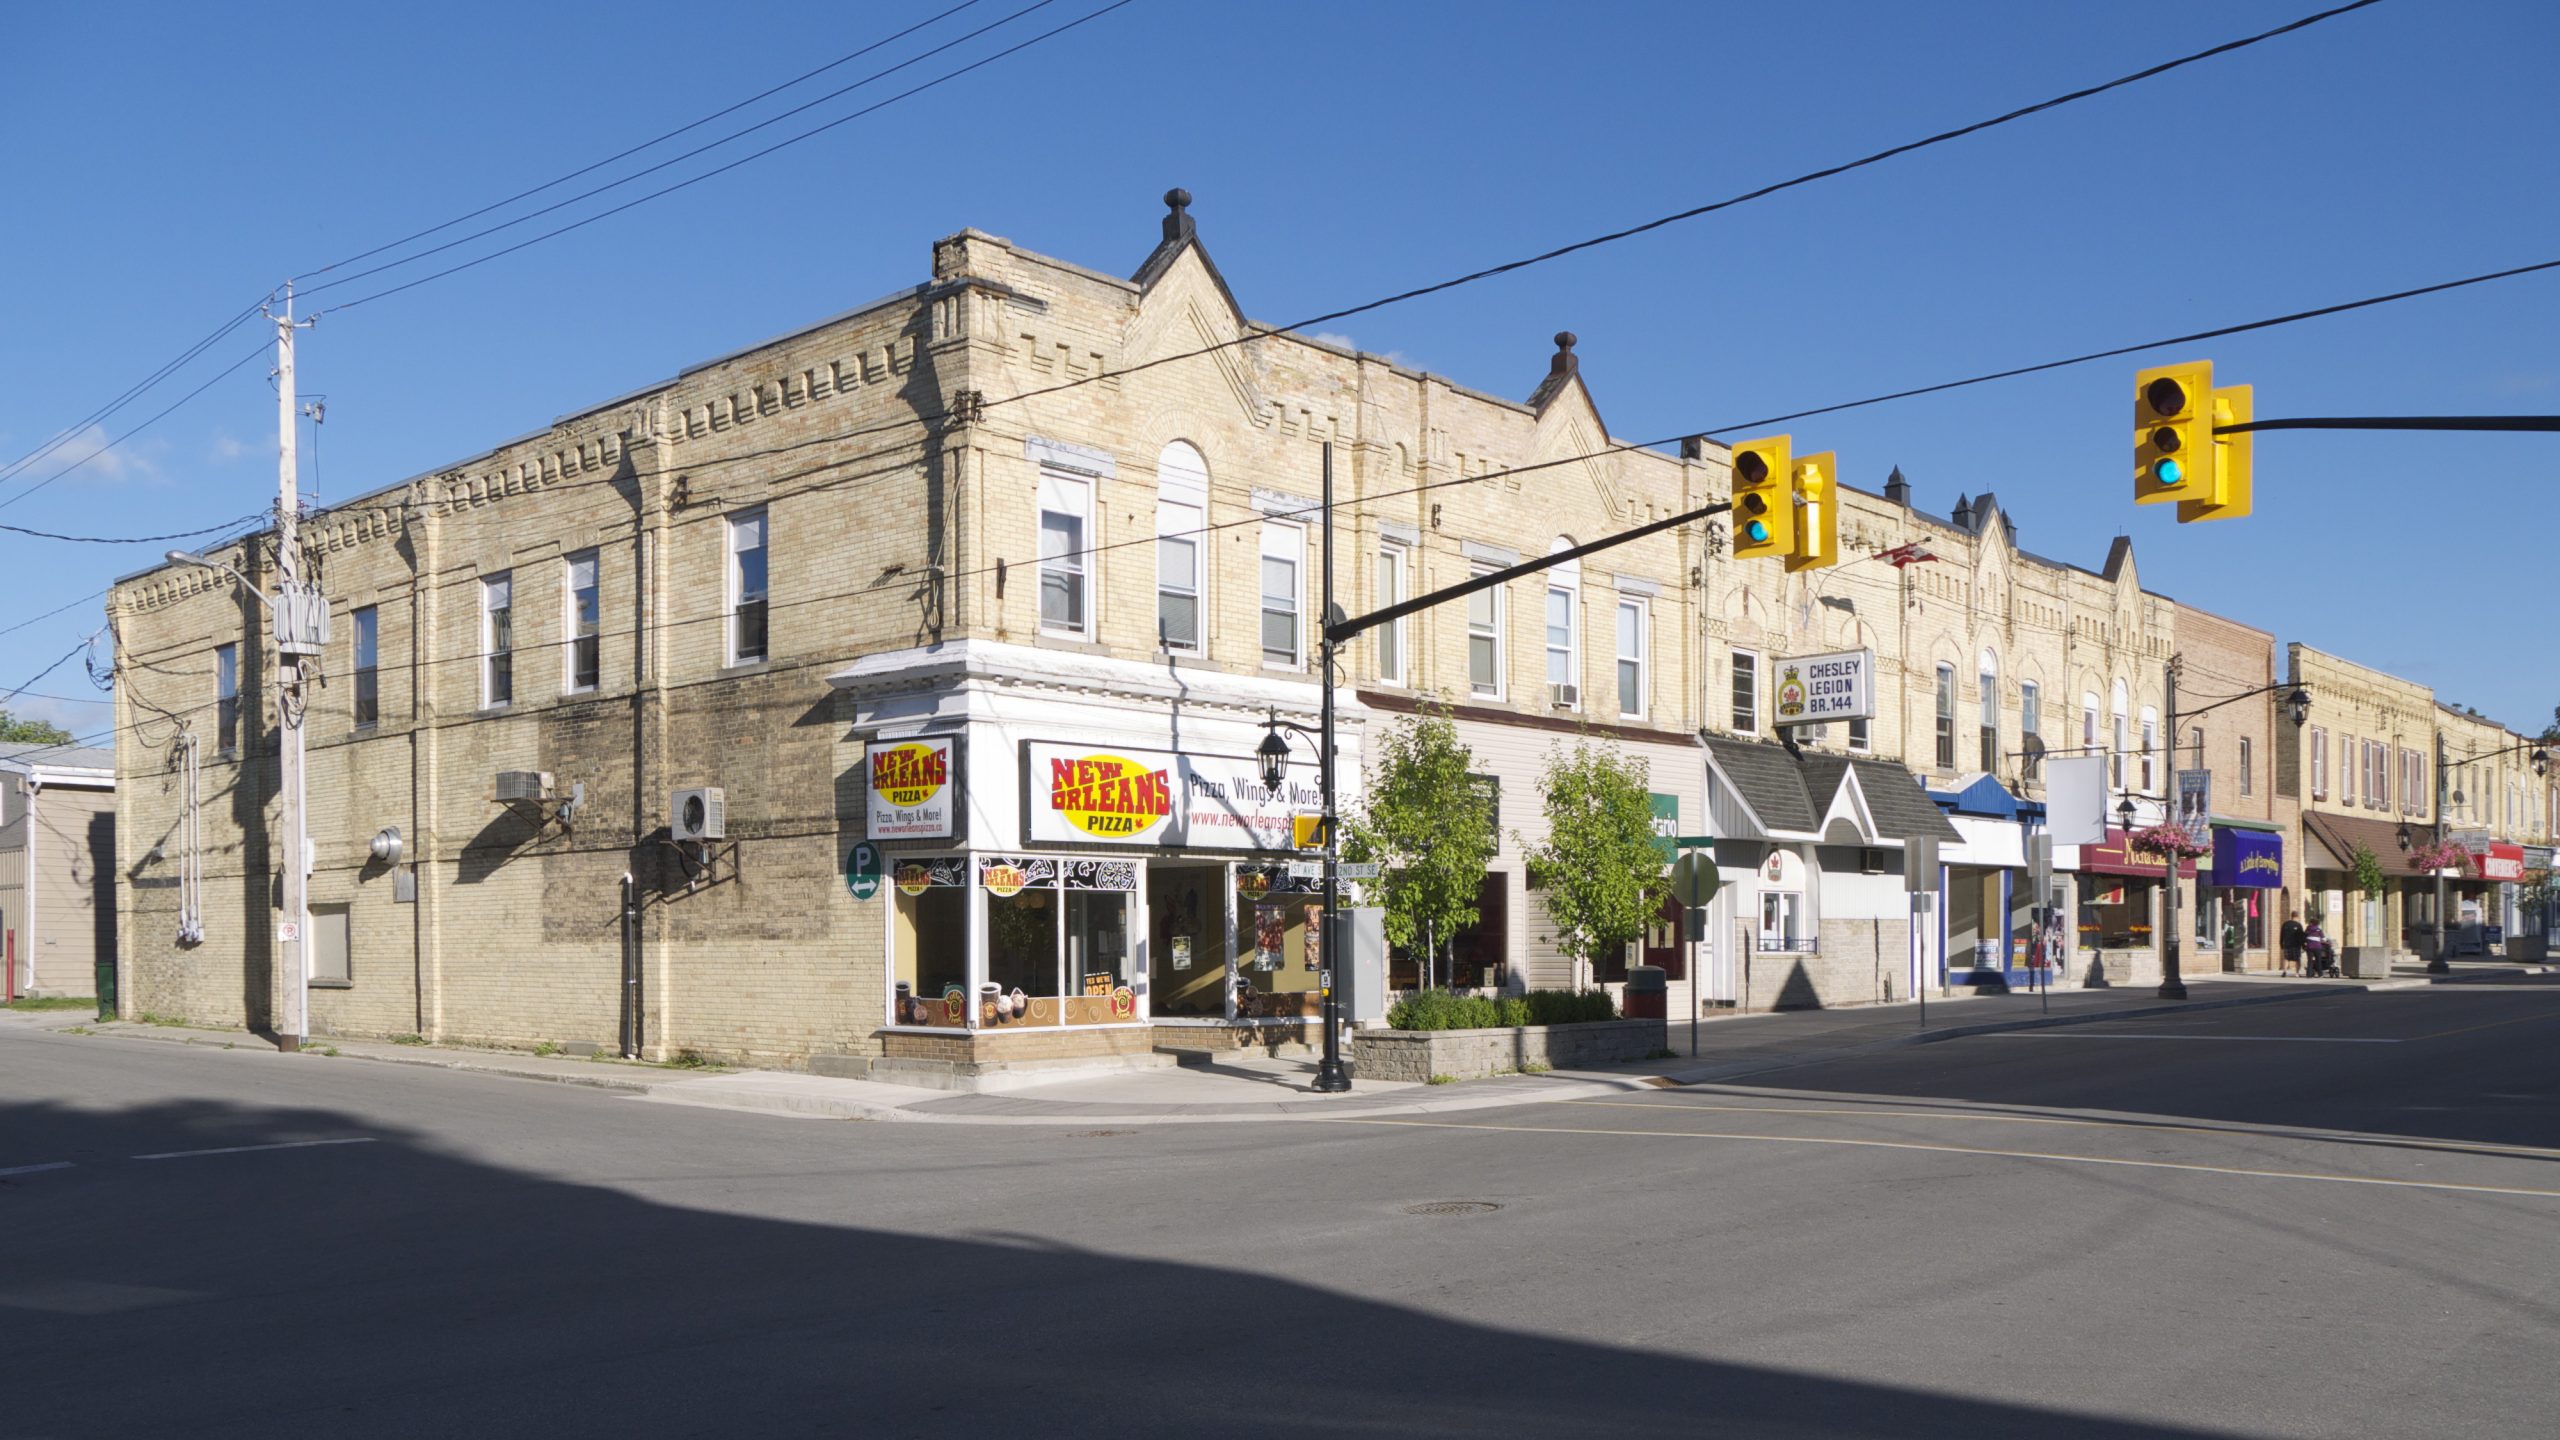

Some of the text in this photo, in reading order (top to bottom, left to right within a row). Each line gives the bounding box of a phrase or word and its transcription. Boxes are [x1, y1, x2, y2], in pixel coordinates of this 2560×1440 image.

[1810, 660, 1860, 678] CHESLEY
[1810, 678, 1852, 695] LEGION
[1810, 696, 1852, 713] BR.144
[872, 749, 916, 774] NEW
[872, 747, 946, 790] ORLEANS
[1051, 757, 1123, 791] NEW
[893, 790, 921, 803] PIZZA
[1052, 768, 1171, 816] ORLEANS
[1190, 773, 1323, 807] Pizza, Wings & More!
[876, 807, 942, 825] Pizza, Wings & More!
[1087, 815, 1133, 832] PIZZA
[1290, 863, 1301, 875] 1ST
[1303, 864, 1315, 876] AVE
[1338, 864, 1376, 876] 2ND ST SE
[1086, 984, 1112, 996] OPEN
